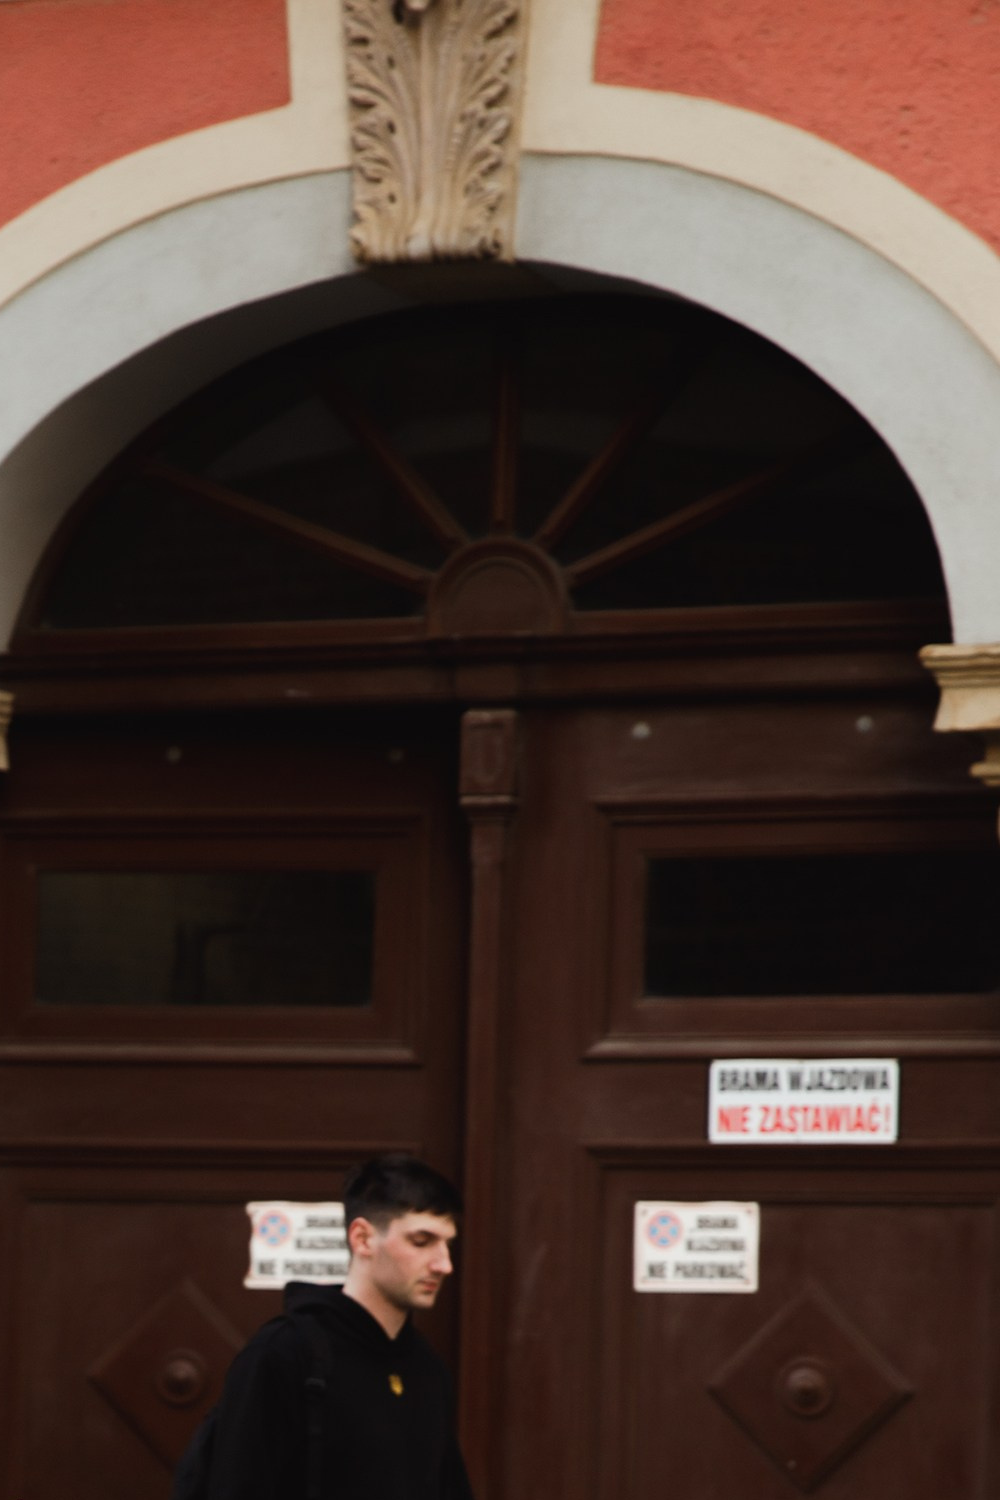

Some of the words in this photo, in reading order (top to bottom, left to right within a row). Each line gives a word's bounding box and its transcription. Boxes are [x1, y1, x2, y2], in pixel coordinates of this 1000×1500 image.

[718, 1069, 779, 1092] BRAMA
[787, 1068, 890, 1091] WJAZDOWA
[717, 1106, 749, 1133] NIE
